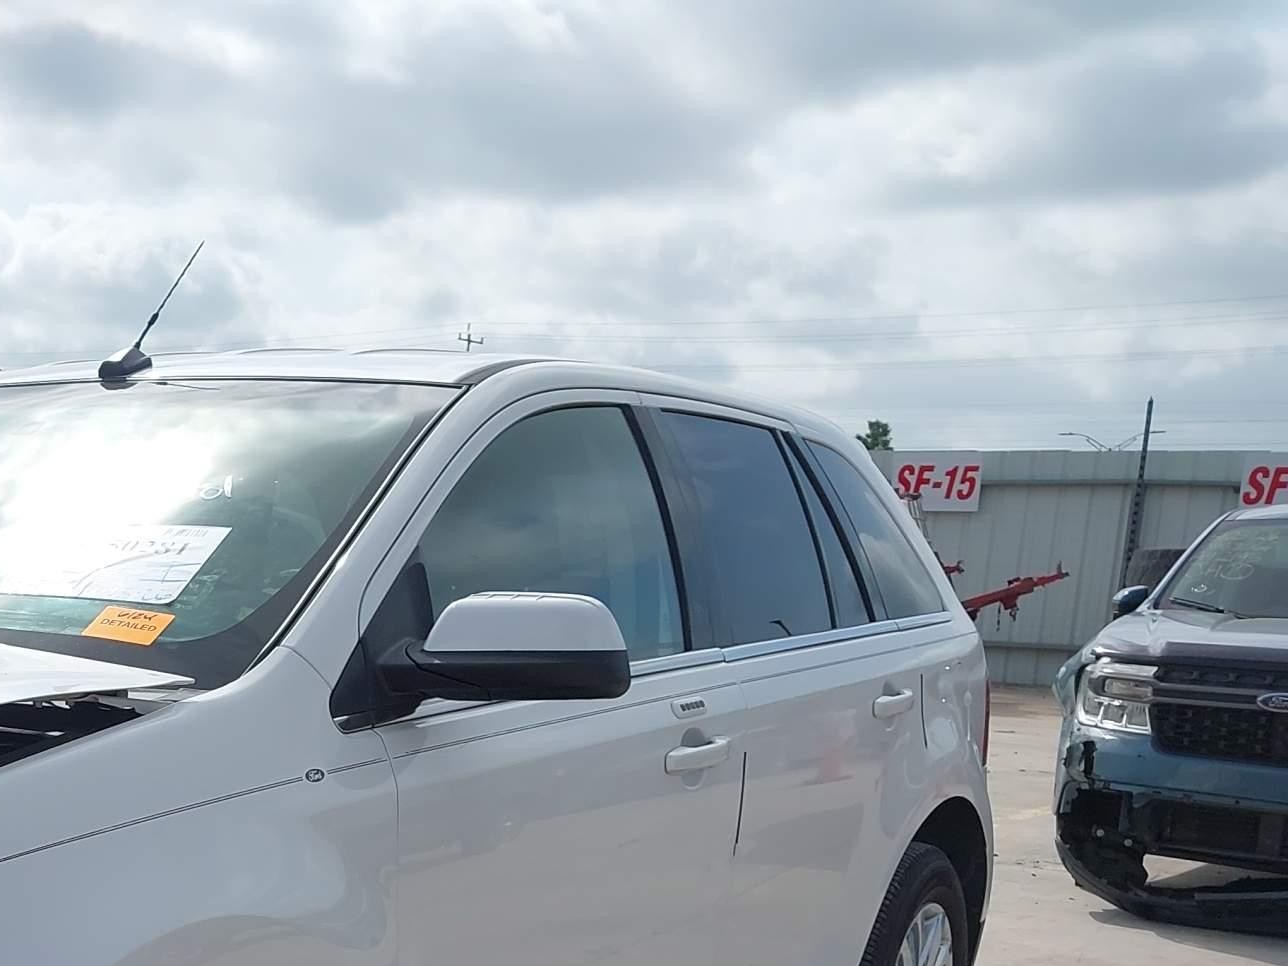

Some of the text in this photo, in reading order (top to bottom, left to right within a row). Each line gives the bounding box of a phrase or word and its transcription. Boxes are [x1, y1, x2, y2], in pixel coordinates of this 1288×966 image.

[896, 464, 981, 501] SF-15
[1242, 465, 1288, 506] SF
[100, 618, 157, 632] DETAILED
